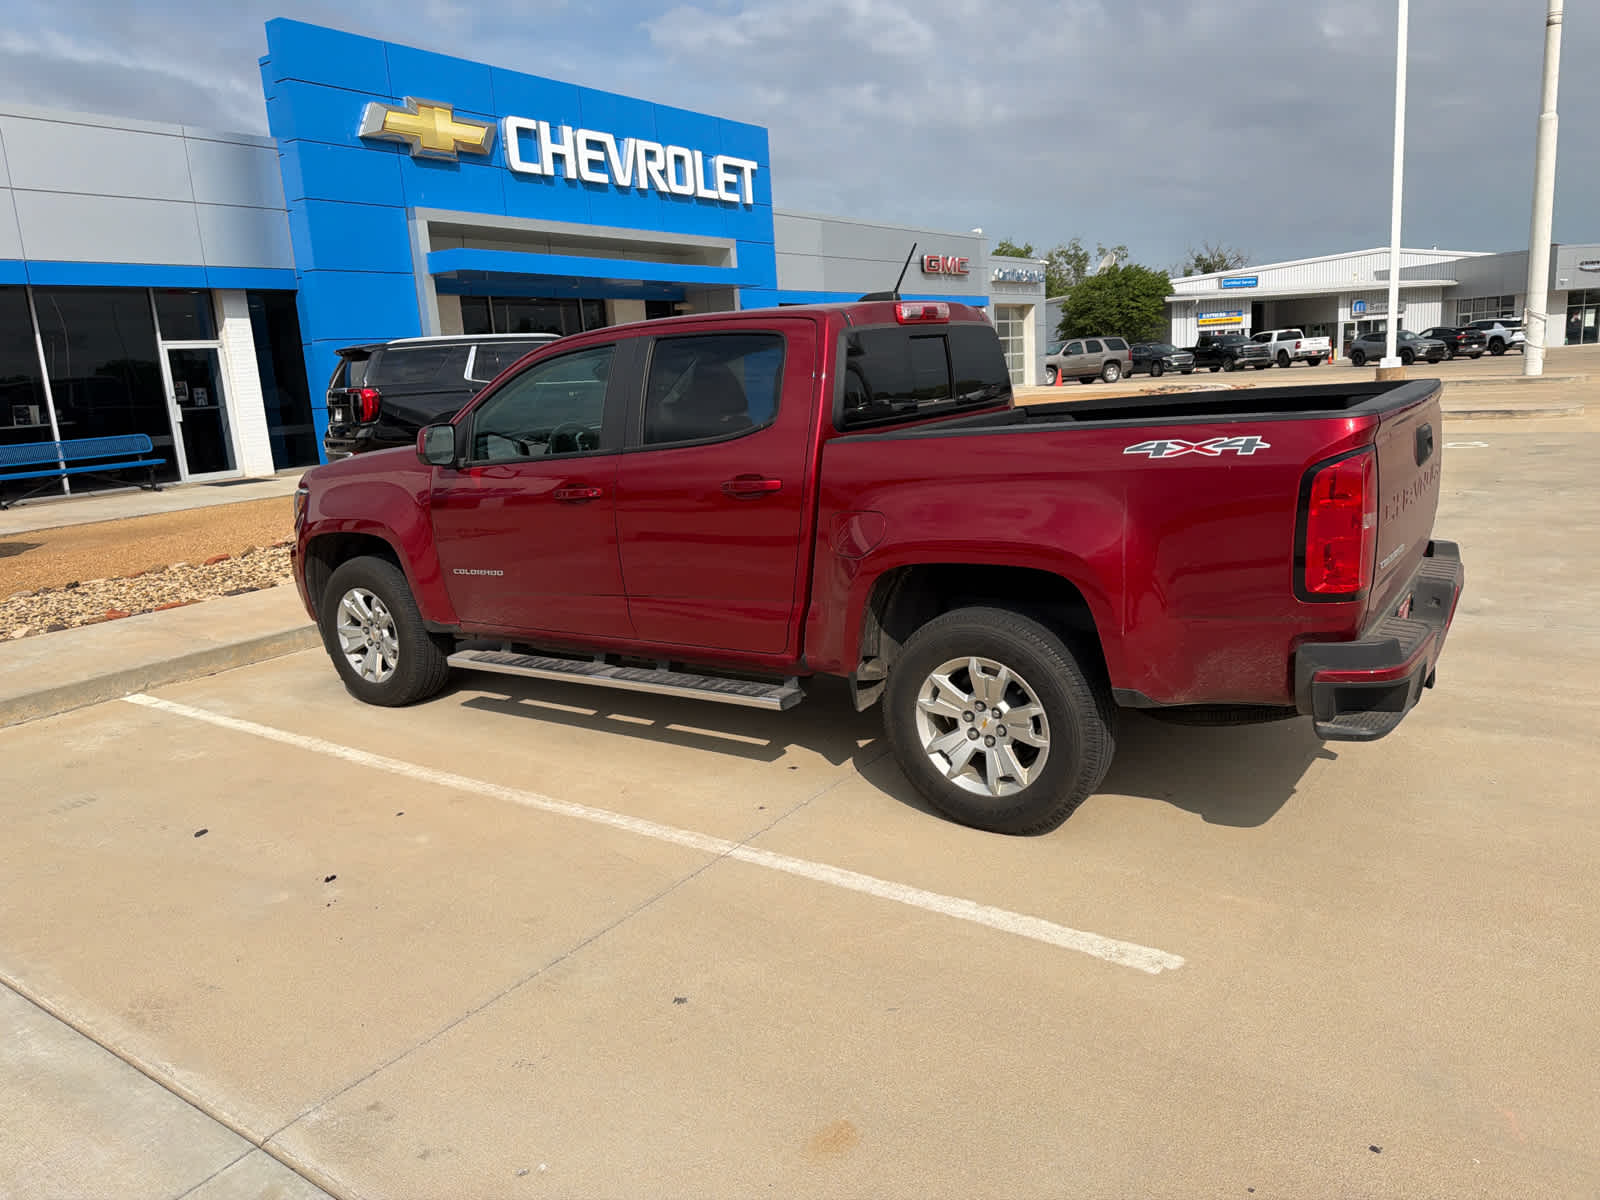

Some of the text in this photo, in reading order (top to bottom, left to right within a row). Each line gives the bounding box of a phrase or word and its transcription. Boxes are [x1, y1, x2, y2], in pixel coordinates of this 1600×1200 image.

[501, 115, 758, 205] CHEVROLET
[922, 255, 970, 275] GMC
[452, 568, 505, 577] COLORADO
